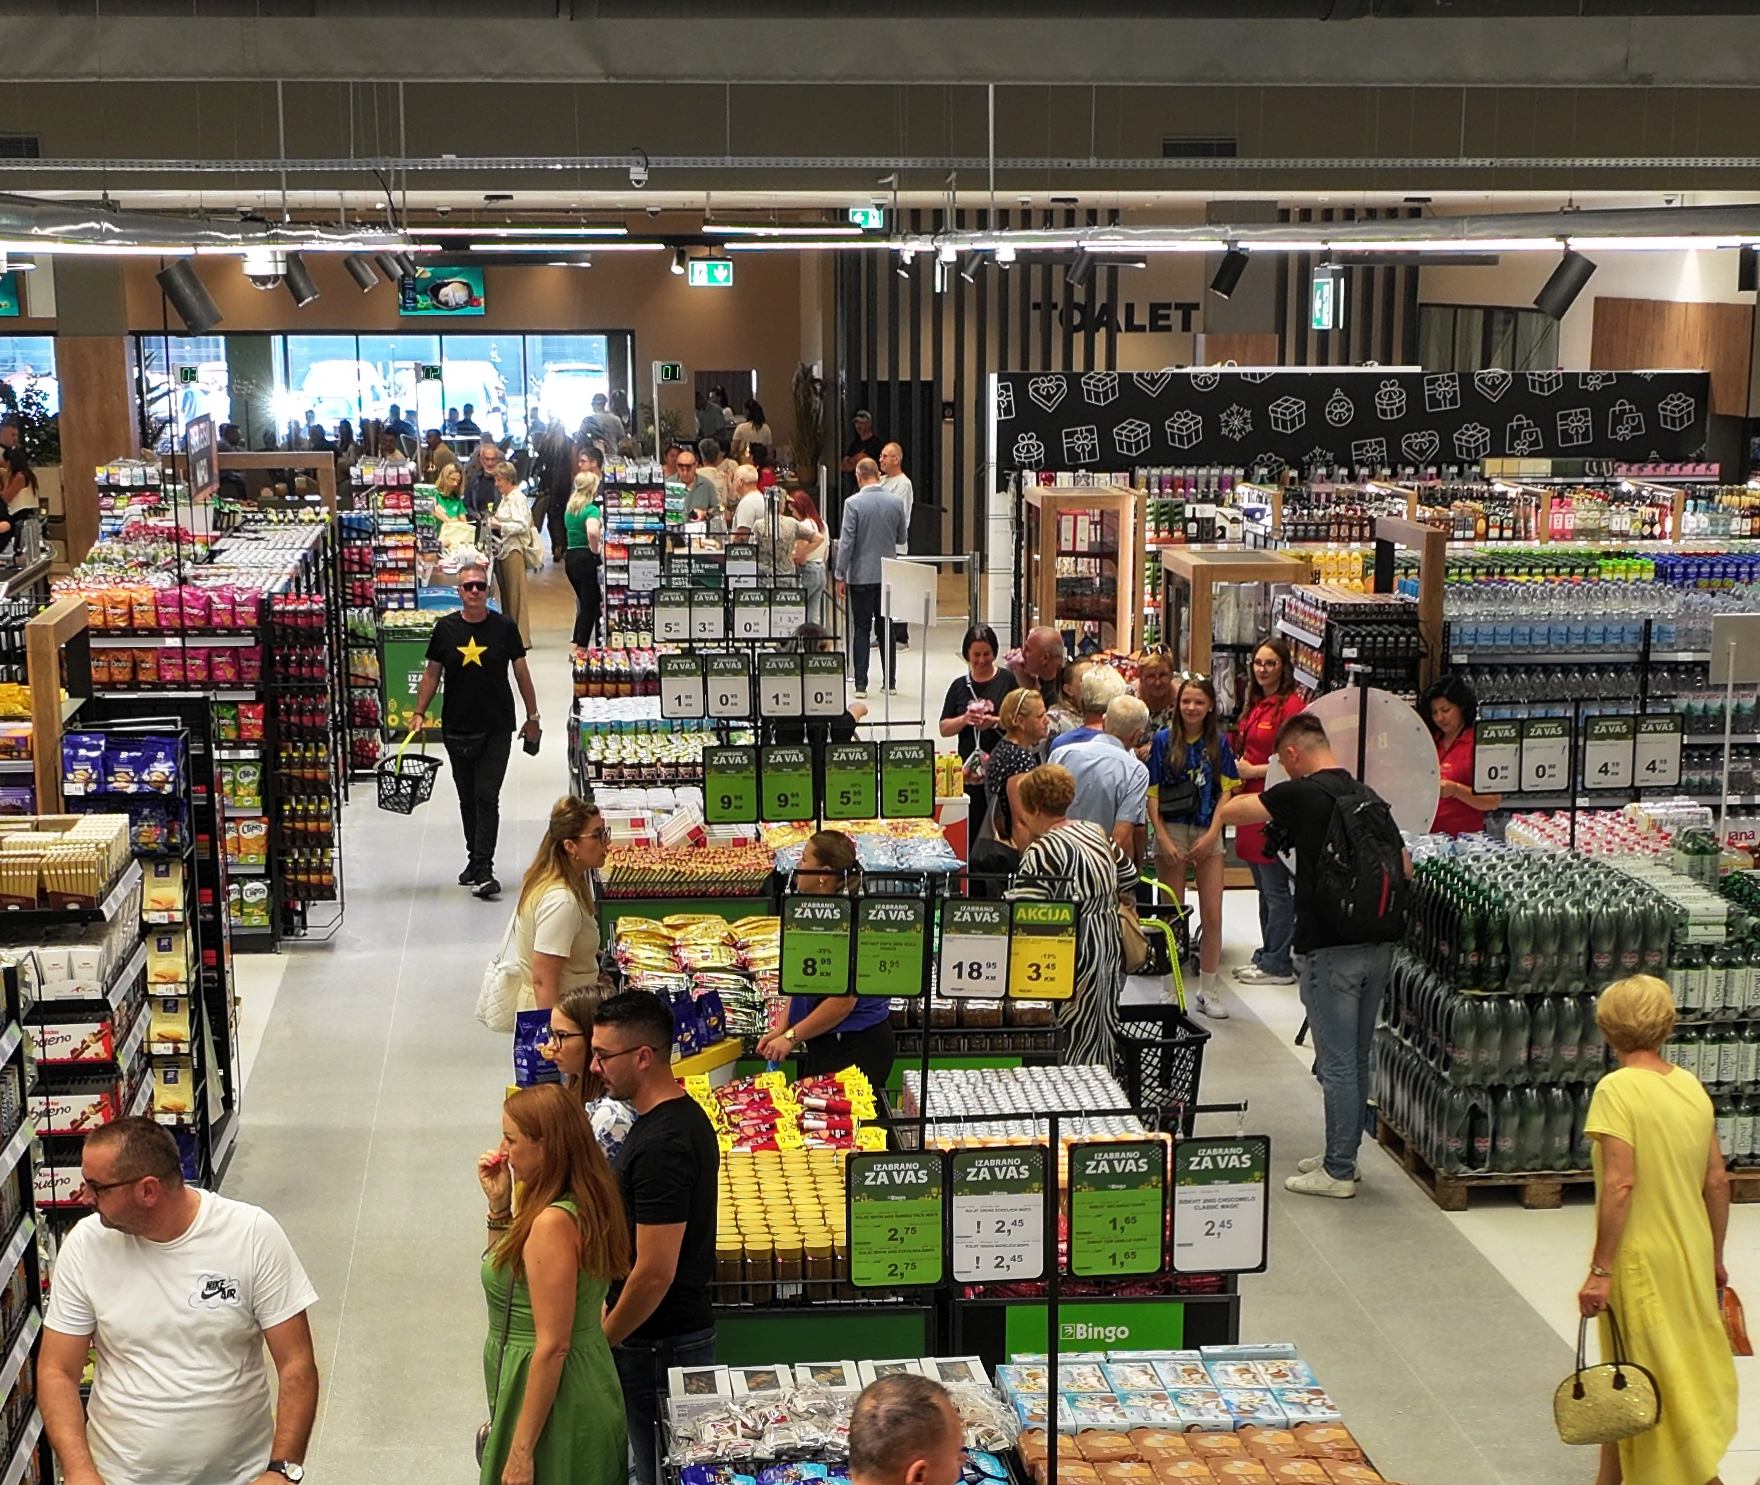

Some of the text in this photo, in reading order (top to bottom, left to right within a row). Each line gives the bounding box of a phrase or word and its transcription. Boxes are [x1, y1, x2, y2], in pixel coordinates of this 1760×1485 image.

[1032, 301, 1201, 334] TOALET
[662, 364, 681, 381] 01
[729, 755, 748, 764] VAS
[720, 795, 732, 810] 9
[839, 790, 851, 805] 5
[794, 908, 840, 919] ZA VAS
[868, 909, 915, 921] ZA VAS
[953, 911, 1000, 923] ZA VAS
[1016, 908, 1071, 921] AKCIJA
[802, 958, 818, 977] 8
[952, 961, 983, 980] 18
[1027, 962, 1042, 982] 3
[1094, 1151, 1140, 1161] IZABRANO
[1197, 1147, 1243, 1156] IZABRANO
[873, 1162, 919, 1172] IZABRANO
[1085, 1158, 1148, 1174] ZA VAS
[1189, 1154, 1252, 1170] ZA VAS
[864, 1169, 928, 1185] ZA VAS
[1108, 1216, 1137, 1233] 1,65
[1204, 1219, 1233, 1239] 2,45
[887, 1227, 917, 1244] 2,75
[1108, 1251, 1137, 1268] 1,65
[887, 1262, 917, 1280] 2,75
[1076, 1323, 1129, 1341] Bingo
